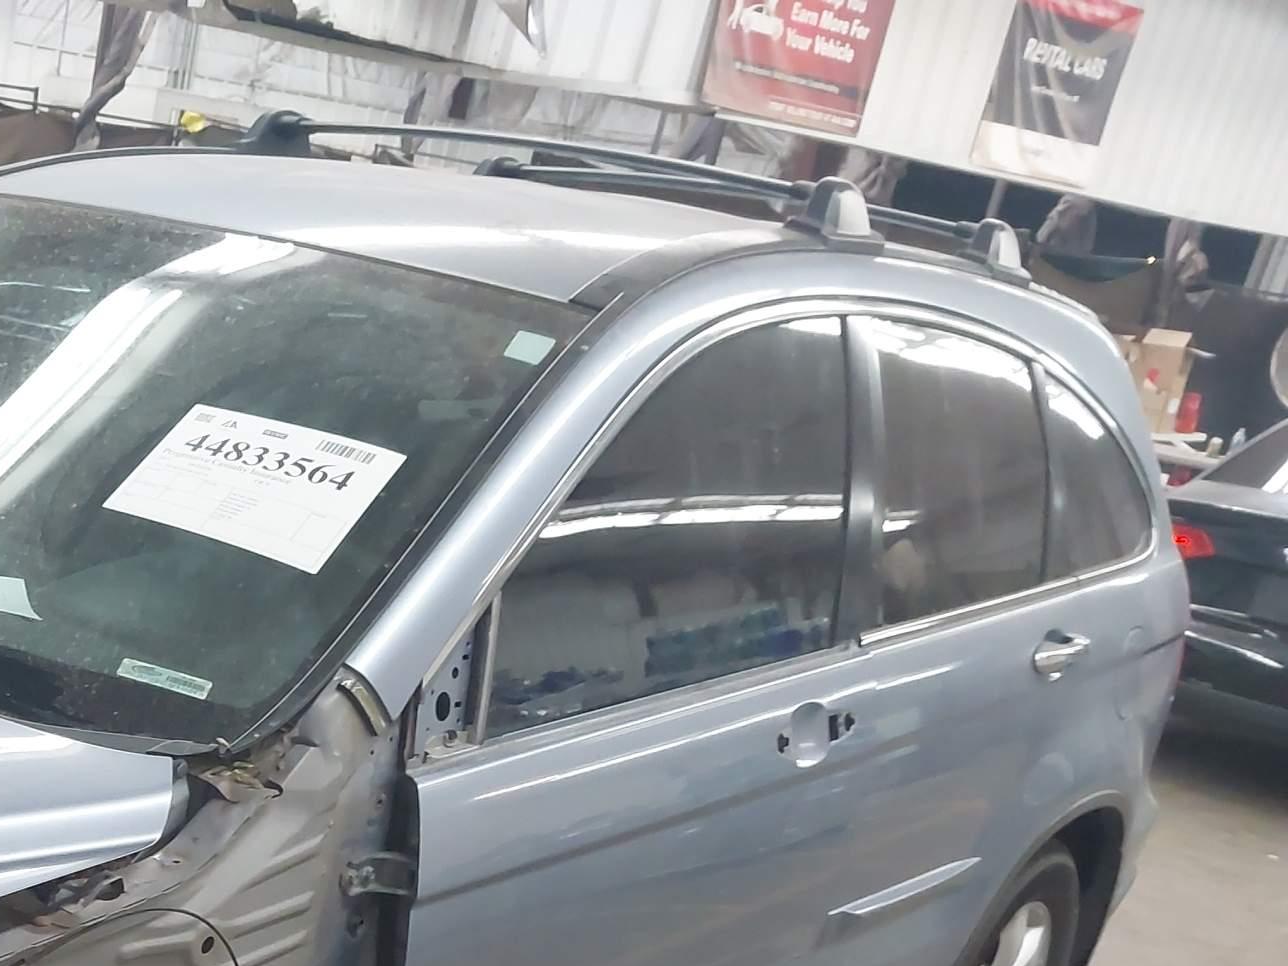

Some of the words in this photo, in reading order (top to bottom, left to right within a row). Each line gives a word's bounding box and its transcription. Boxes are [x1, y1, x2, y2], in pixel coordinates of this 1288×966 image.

[791, 2, 819, 26] Earn
[819, 10, 850, 35] More
[850, 19, 870, 40] For
[786, 27, 812, 51] Your
[814, 35, 855, 63] Vehicle
[185, 433, 356, 491] 44833564
